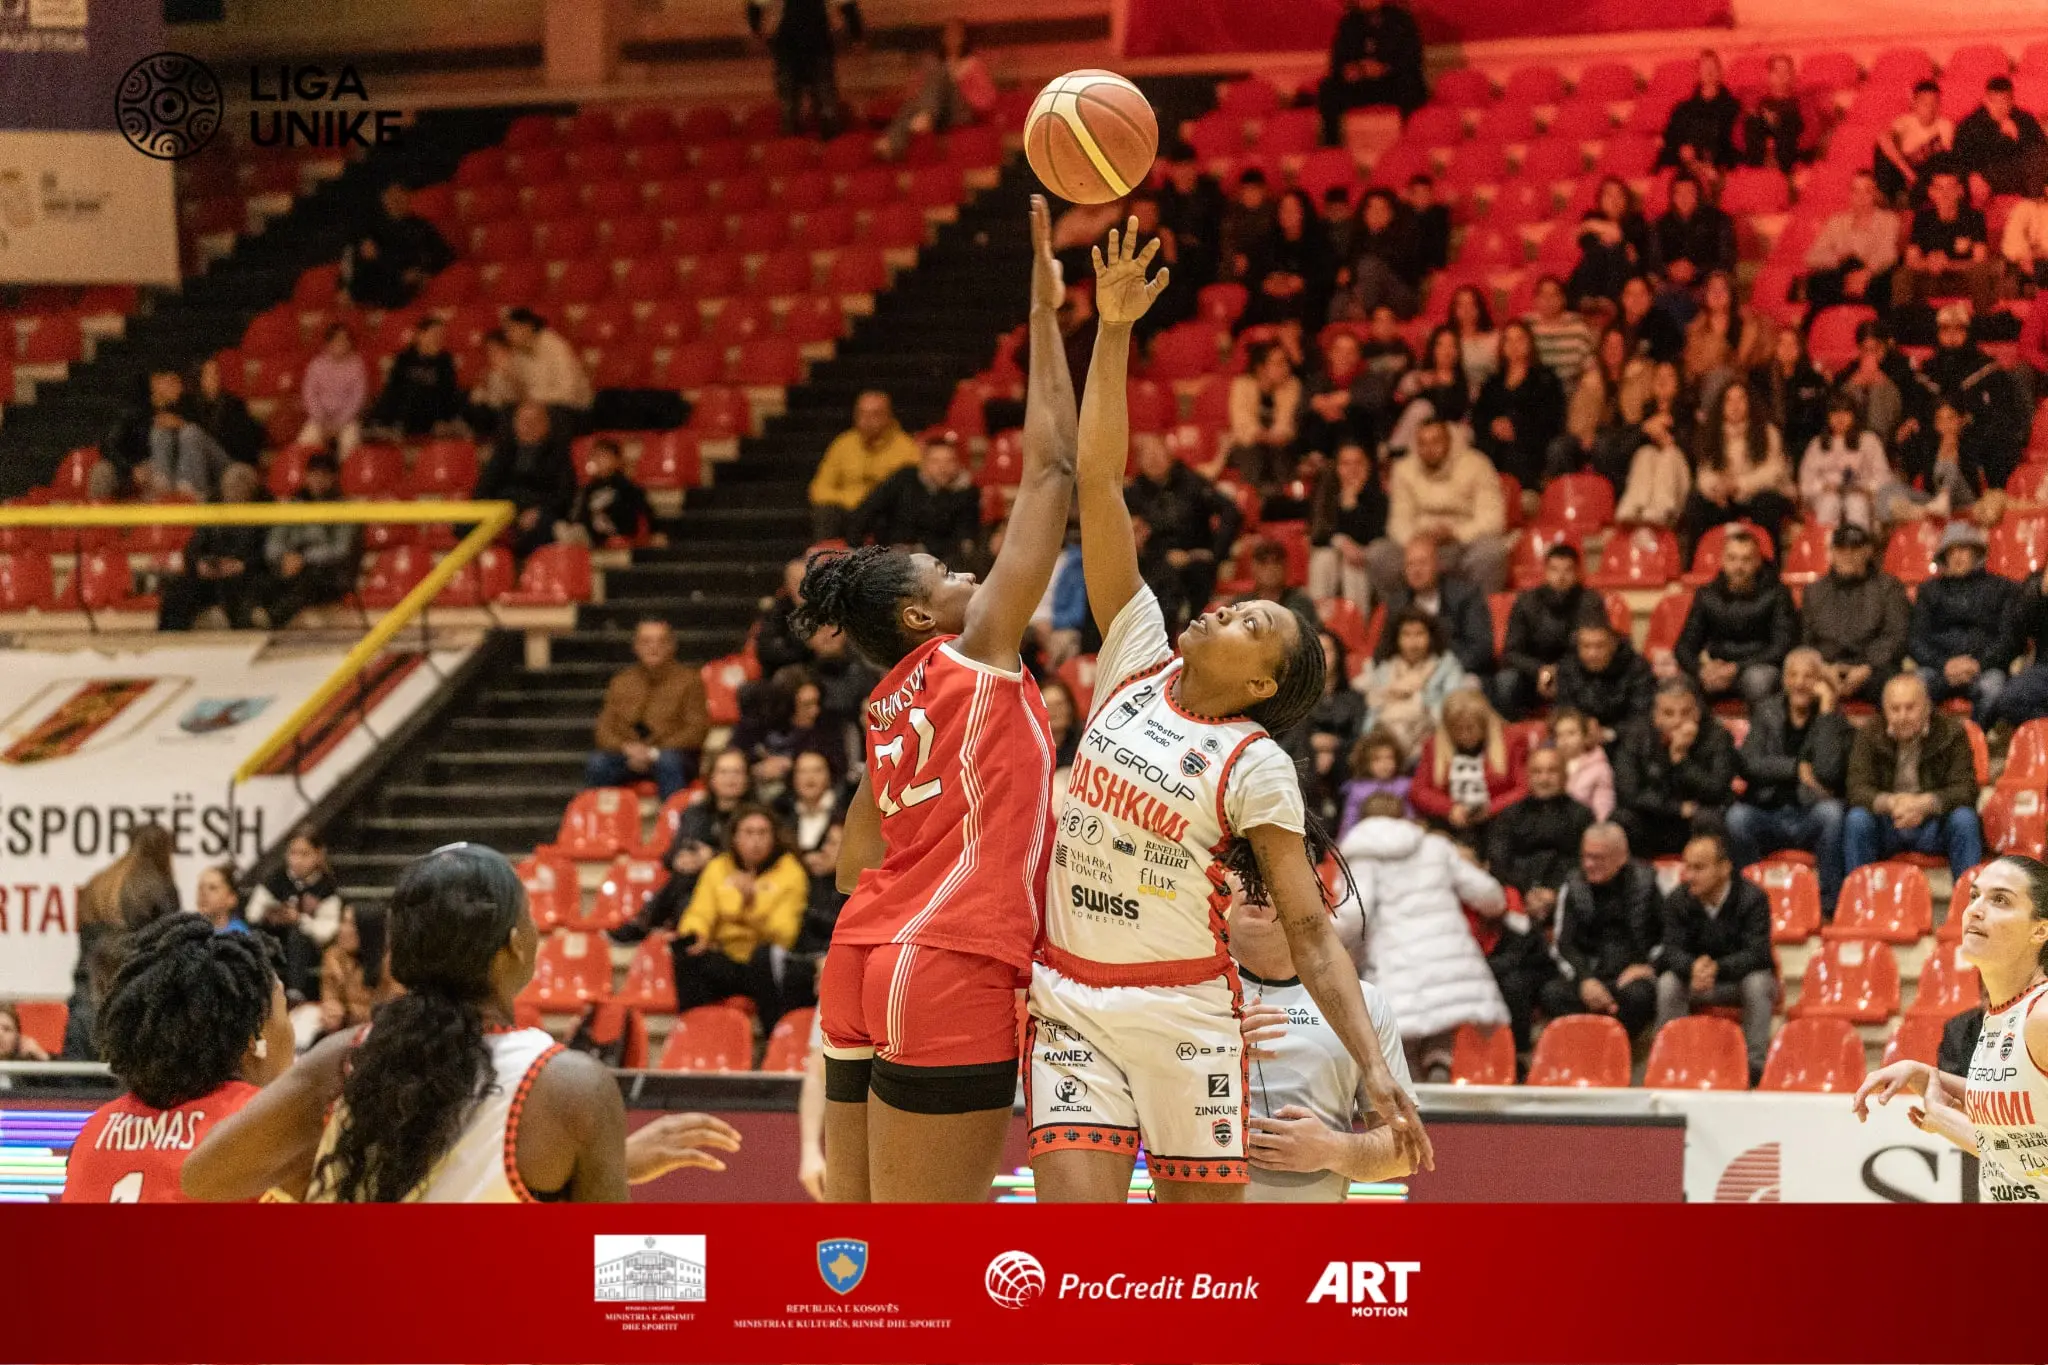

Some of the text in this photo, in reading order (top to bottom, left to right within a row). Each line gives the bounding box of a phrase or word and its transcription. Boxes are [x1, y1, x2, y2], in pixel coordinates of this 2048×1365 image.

[1144, 729, 1170, 748] studio
[1087, 728, 1195, 801] FAT GROUP
[1068, 752, 1190, 842] BASHKIMI
[1144, 849, 1189, 870] TAHIRI
[1070, 861, 1113, 884] TOWERS
[1140, 867, 1177, 891] flux
[1287, 1016, 1321, 1026] NIKE
[1044, 1050, 1094, 1063] ANNEX
[1966, 1089, 2036, 1126] SHKIMI
[94, 1110, 206, 1151] THOMAS
